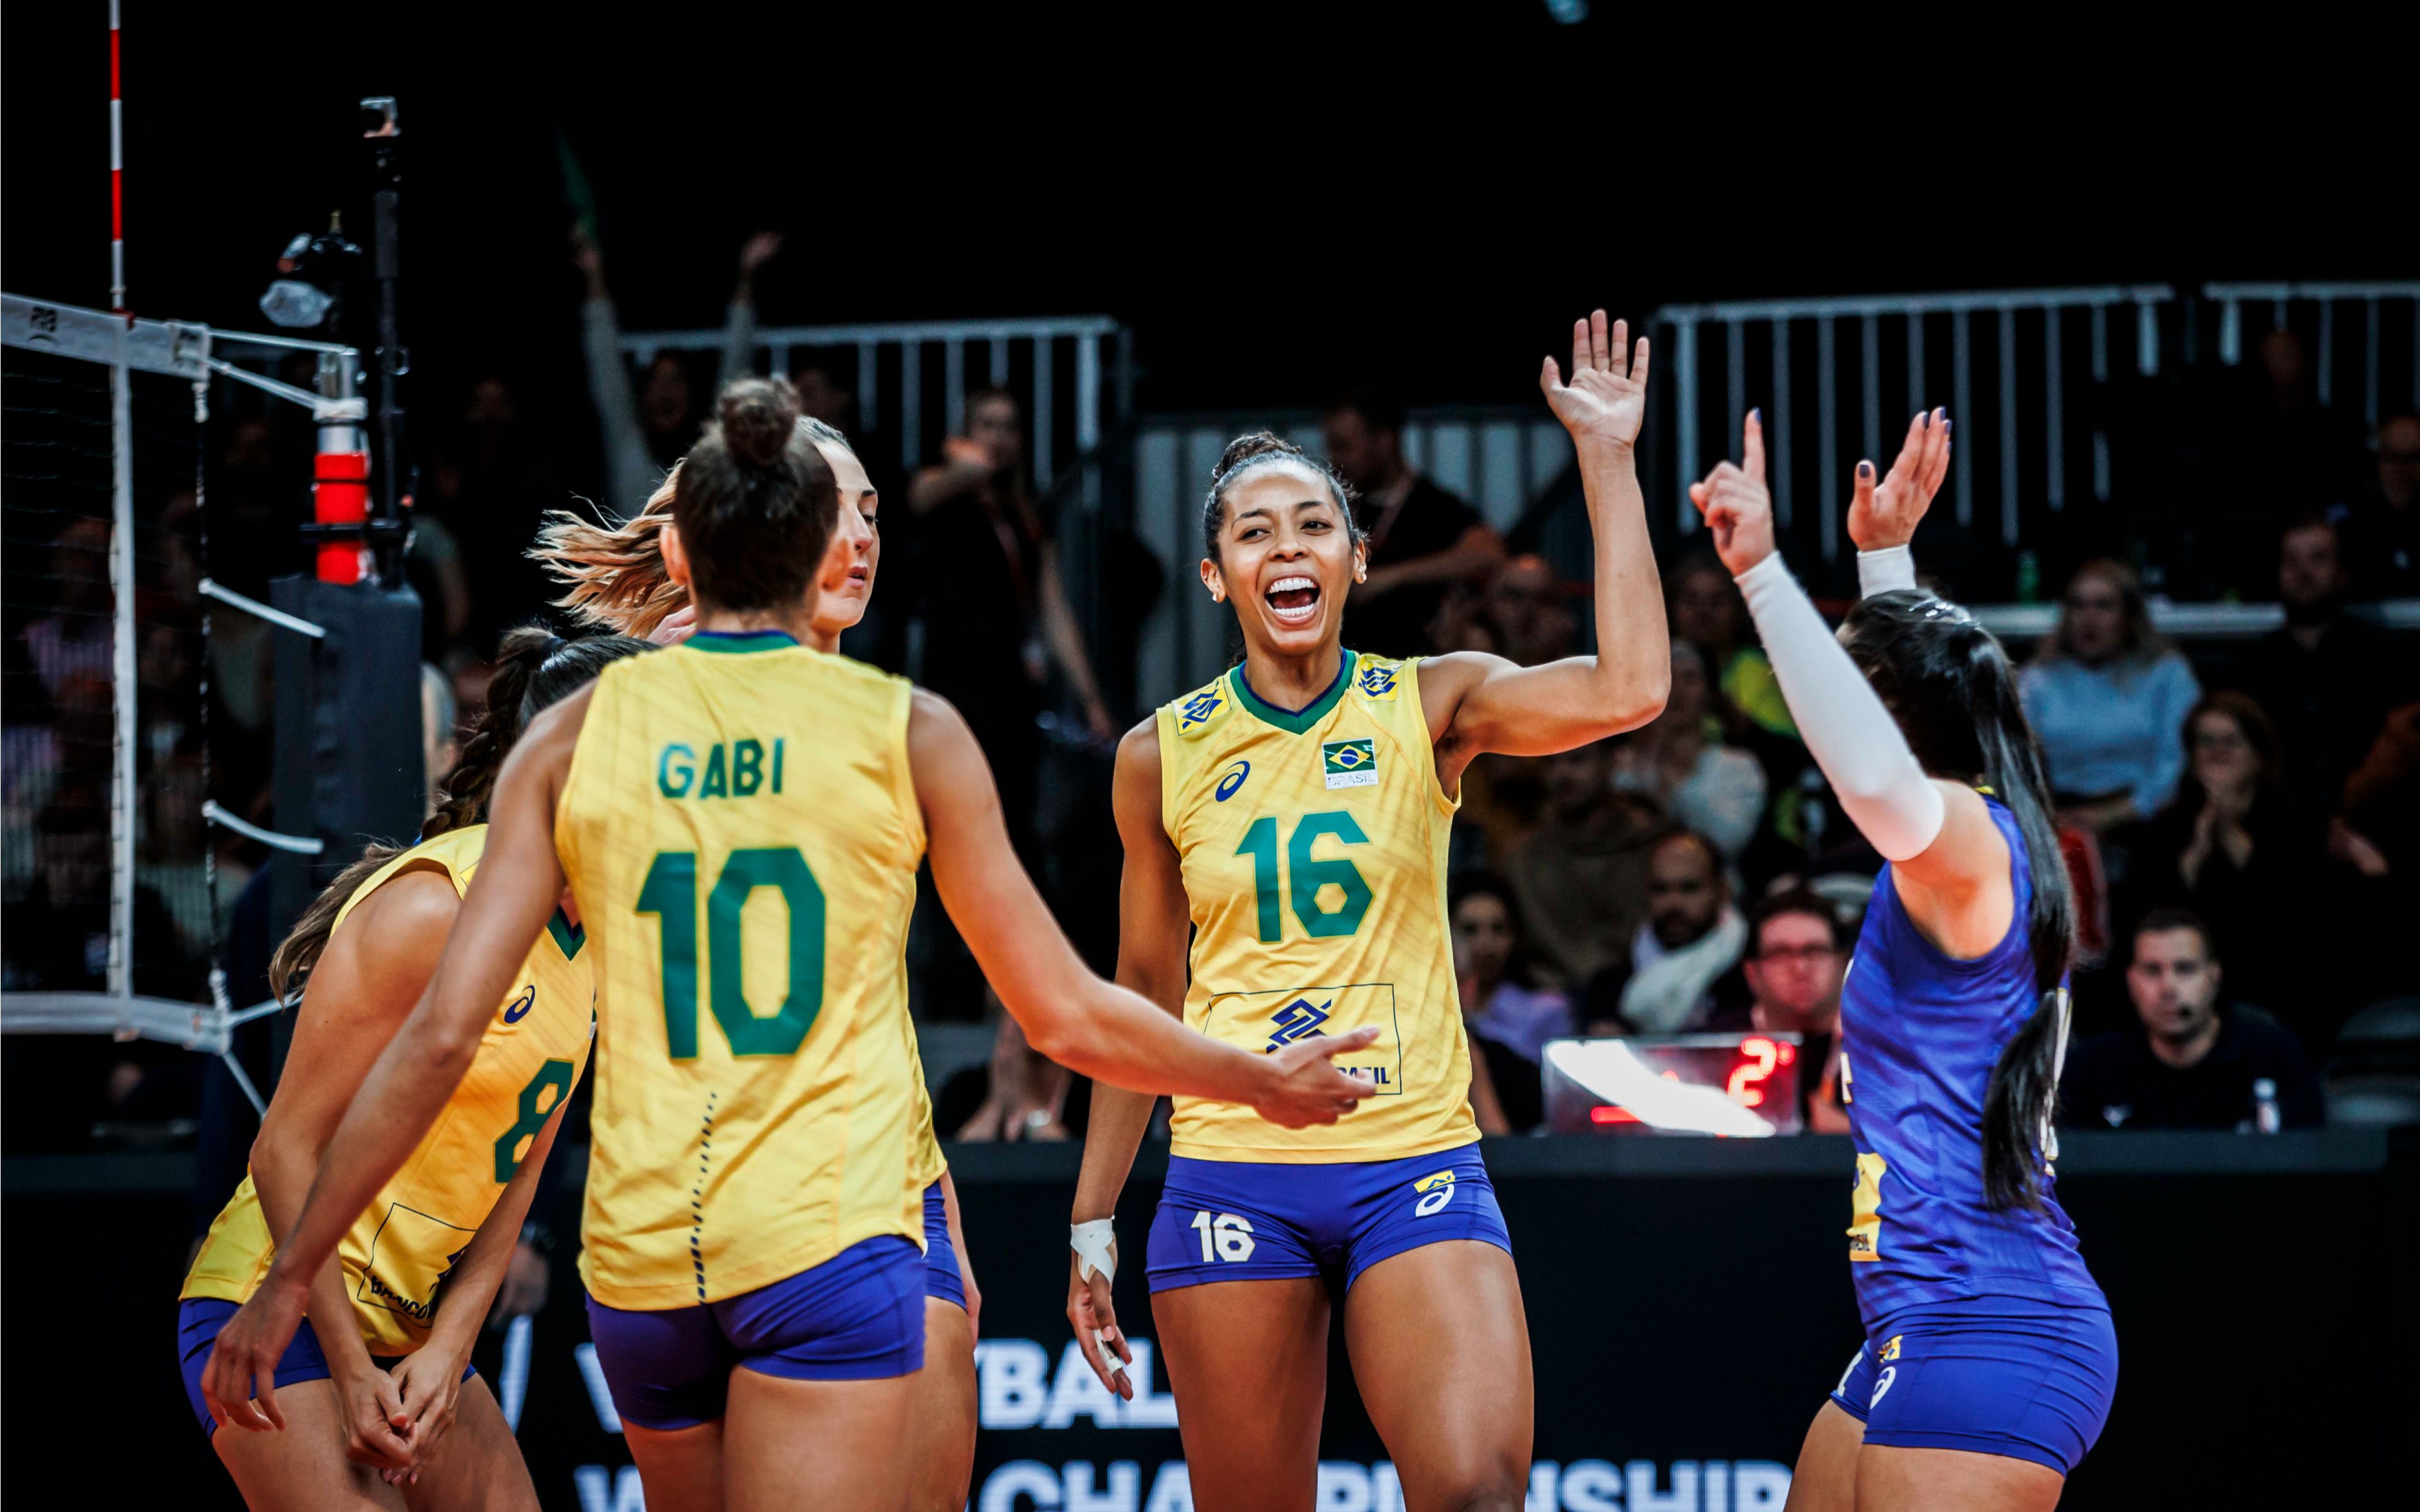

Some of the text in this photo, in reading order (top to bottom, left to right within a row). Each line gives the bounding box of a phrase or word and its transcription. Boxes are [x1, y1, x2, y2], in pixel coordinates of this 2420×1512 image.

[657, 737, 785, 800] GABI
[1234, 810, 1374, 942] 16
[635, 848, 825, 1059] 10
[493, 1057, 575, 1184] 8
[1190, 1210, 1256, 1263] 16
